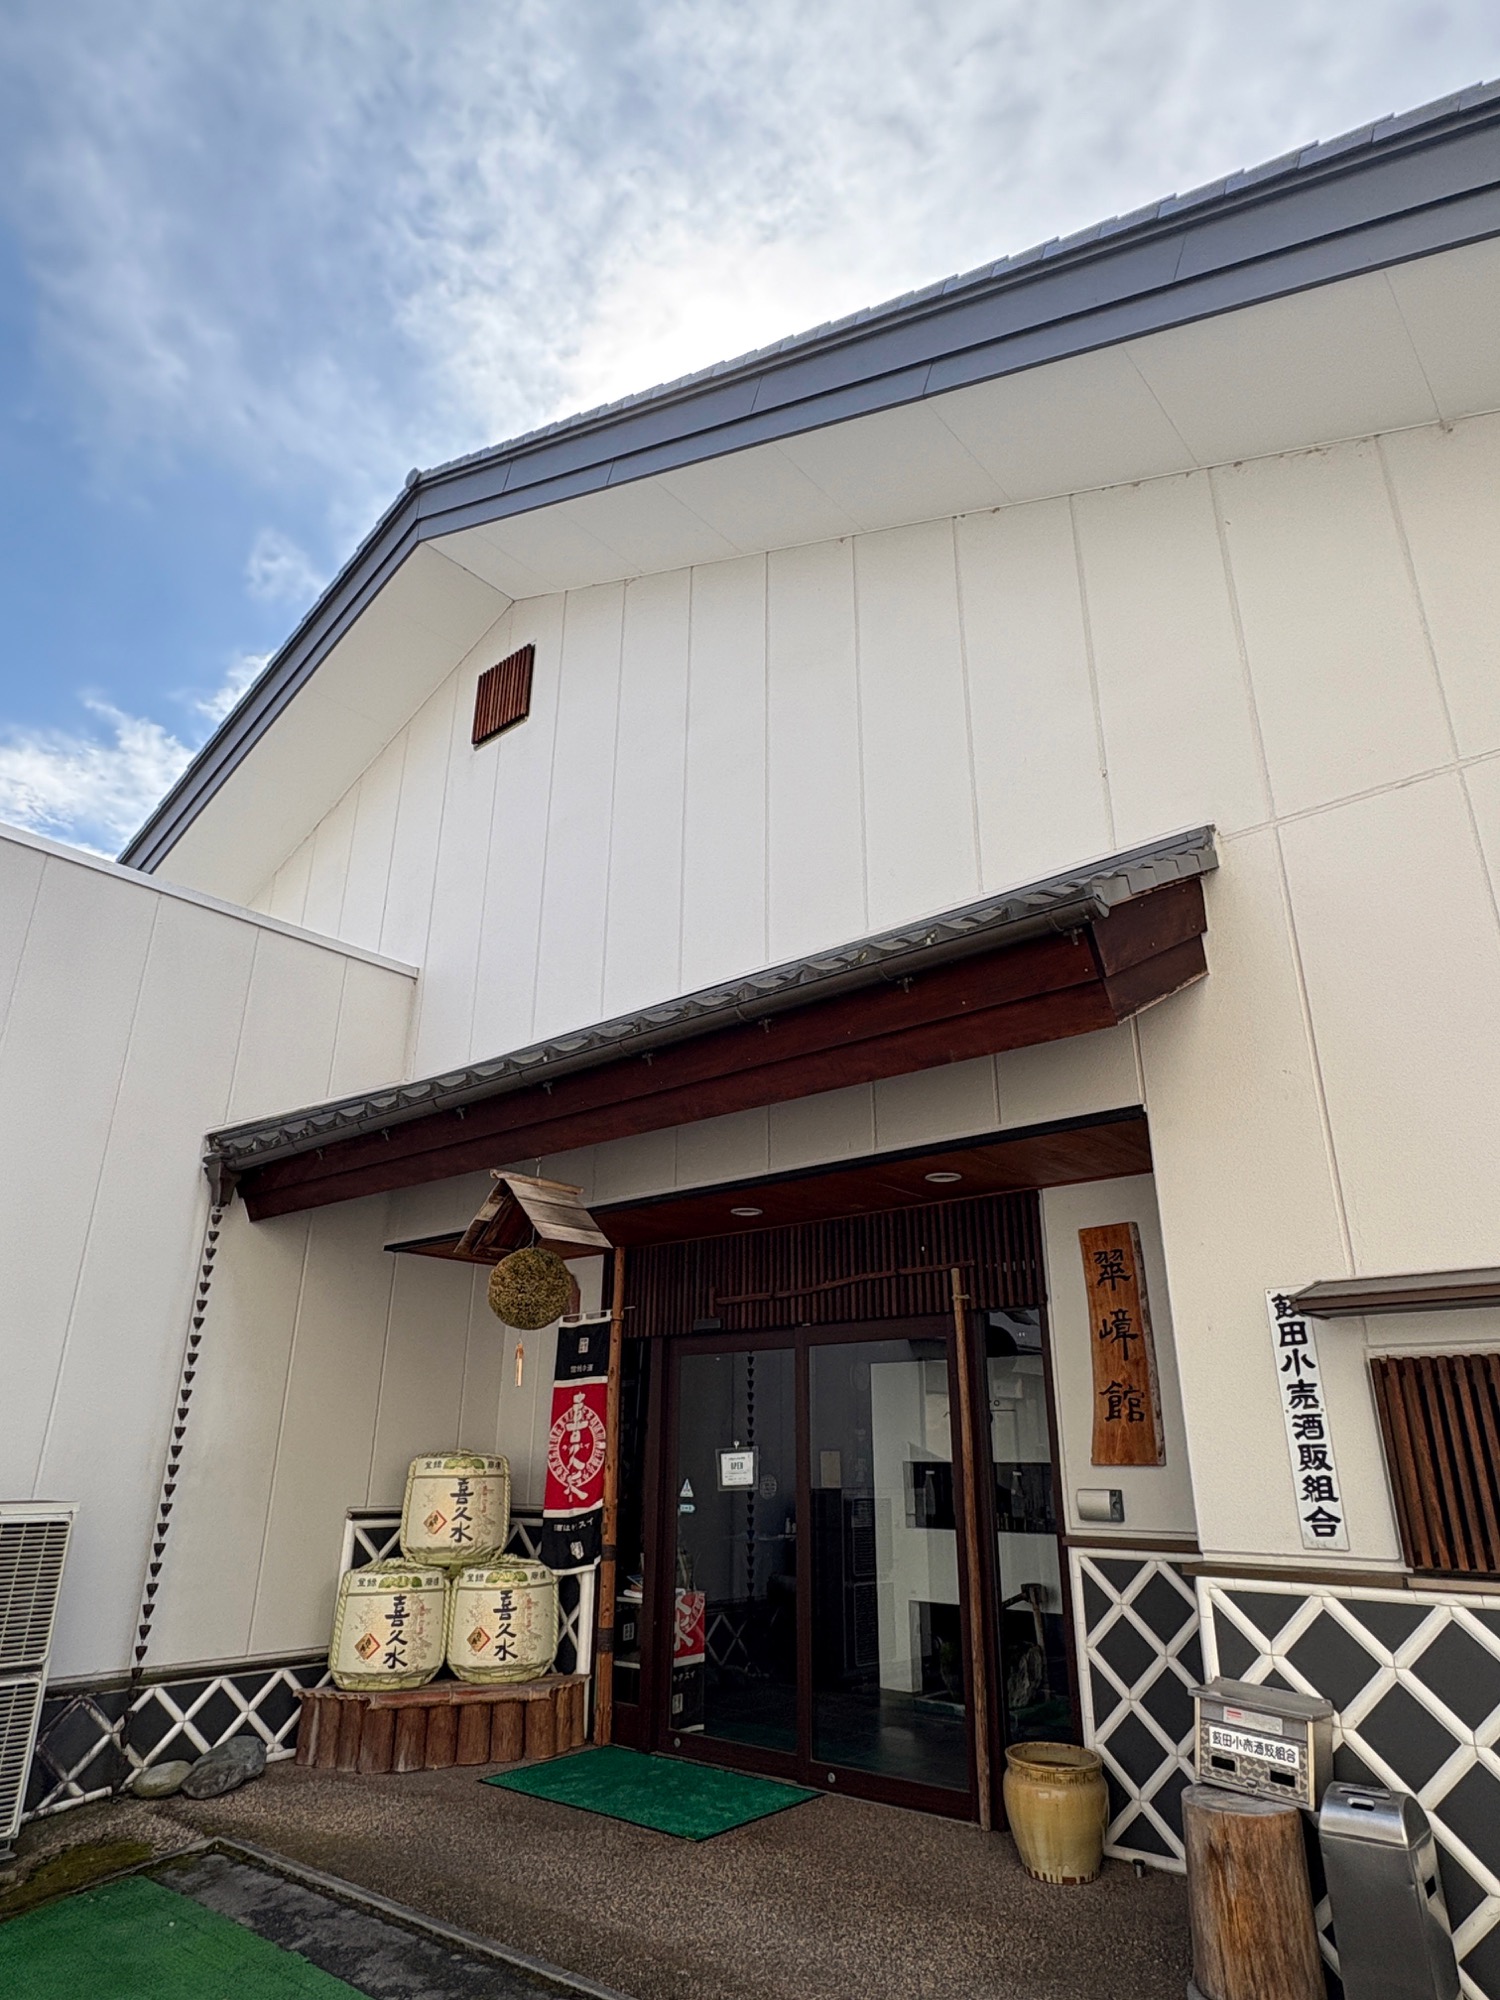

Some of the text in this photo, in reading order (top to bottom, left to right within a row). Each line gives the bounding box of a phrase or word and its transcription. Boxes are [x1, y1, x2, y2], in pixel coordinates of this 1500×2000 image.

[1270, 1291, 1342, 1538] 飯田小売酒販組合
[449, 1476, 475, 1543] 喜久水
[382, 1593, 411, 1669] 喜久水
[492, 1588, 519, 1661] 喜久水
[1211, 1729, 1297, 1764] 飯田小売酒販組合
